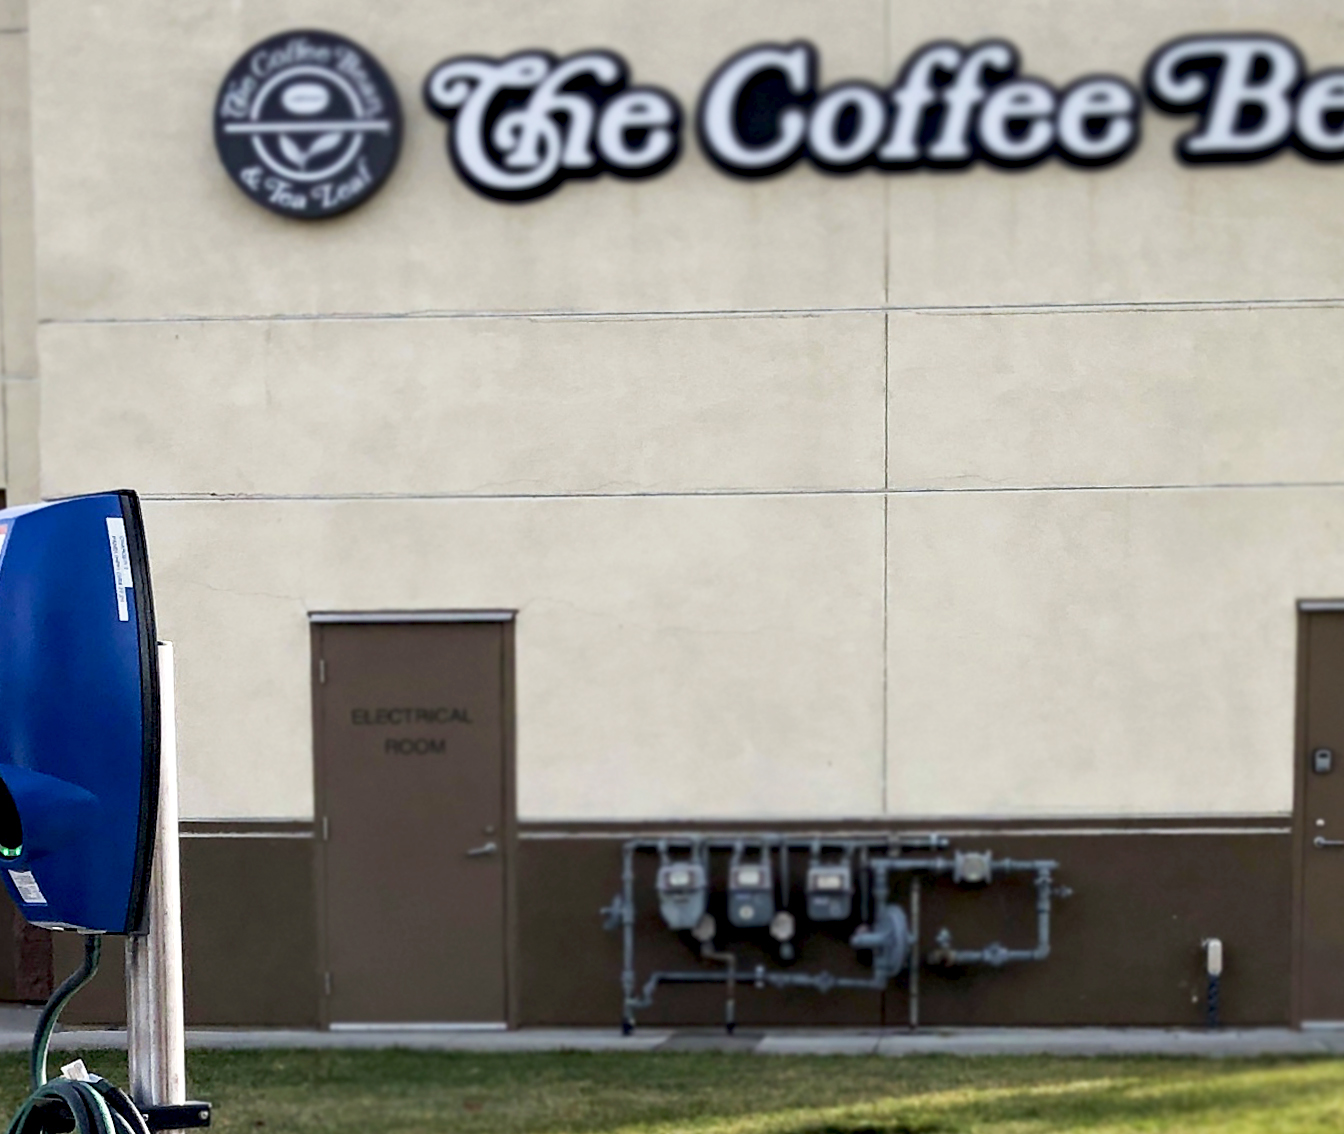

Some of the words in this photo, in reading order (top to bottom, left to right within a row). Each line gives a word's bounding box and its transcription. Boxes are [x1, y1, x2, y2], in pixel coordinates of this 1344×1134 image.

[220, 76, 256, 120] The
[250, 35, 332, 78] Coffee
[334, 46, 384, 117] Bean
[425, 53, 675, 192] The
[700, 41, 1136, 170] Coffee
[239, 165, 264, 192] &
[263, 175, 308, 210] Tea
[309, 156, 374, 209] Leaf
[350, 707, 473, 726] ELECTRICAL
[384, 738, 447, 756] ROOM
